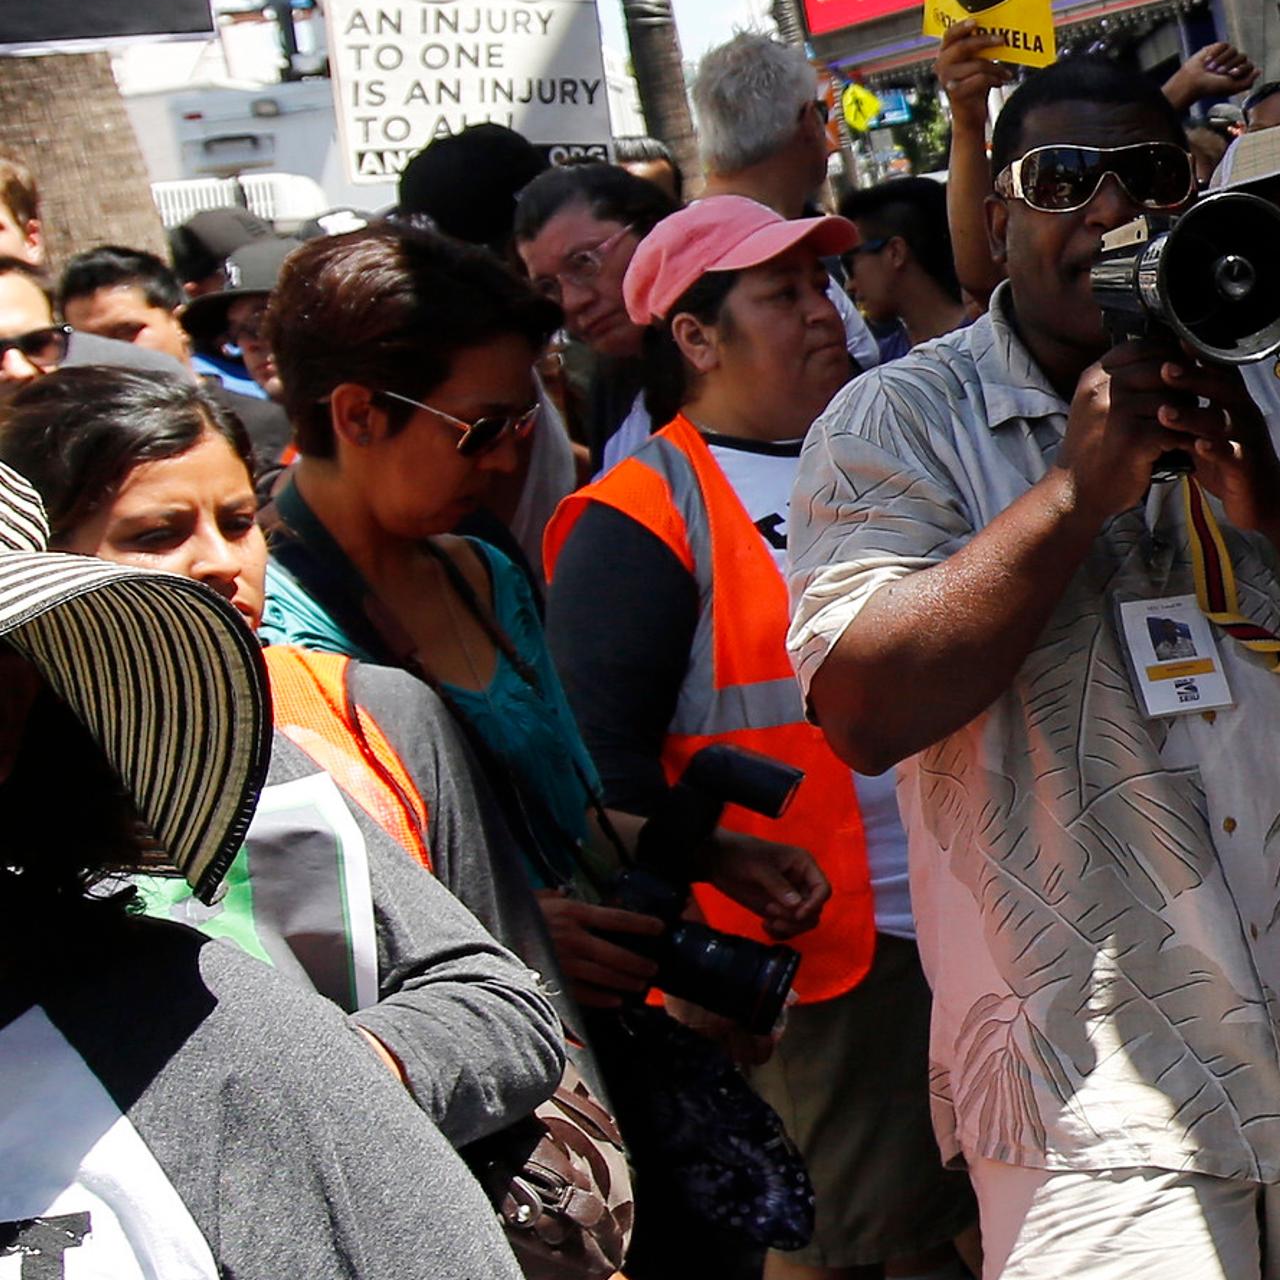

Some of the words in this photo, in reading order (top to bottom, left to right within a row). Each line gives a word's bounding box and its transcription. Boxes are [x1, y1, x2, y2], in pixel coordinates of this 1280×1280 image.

[344, 7, 402, 36] AN
[420, 7, 555, 36] INJURY
[347, 43, 403, 71] TO
[420, 42, 505, 70] ONE
[352, 79, 387, 108] IS
[403, 78, 462, 107] AN
[479, 77, 602, 106] INJURY
[354, 115, 411, 144] TO
